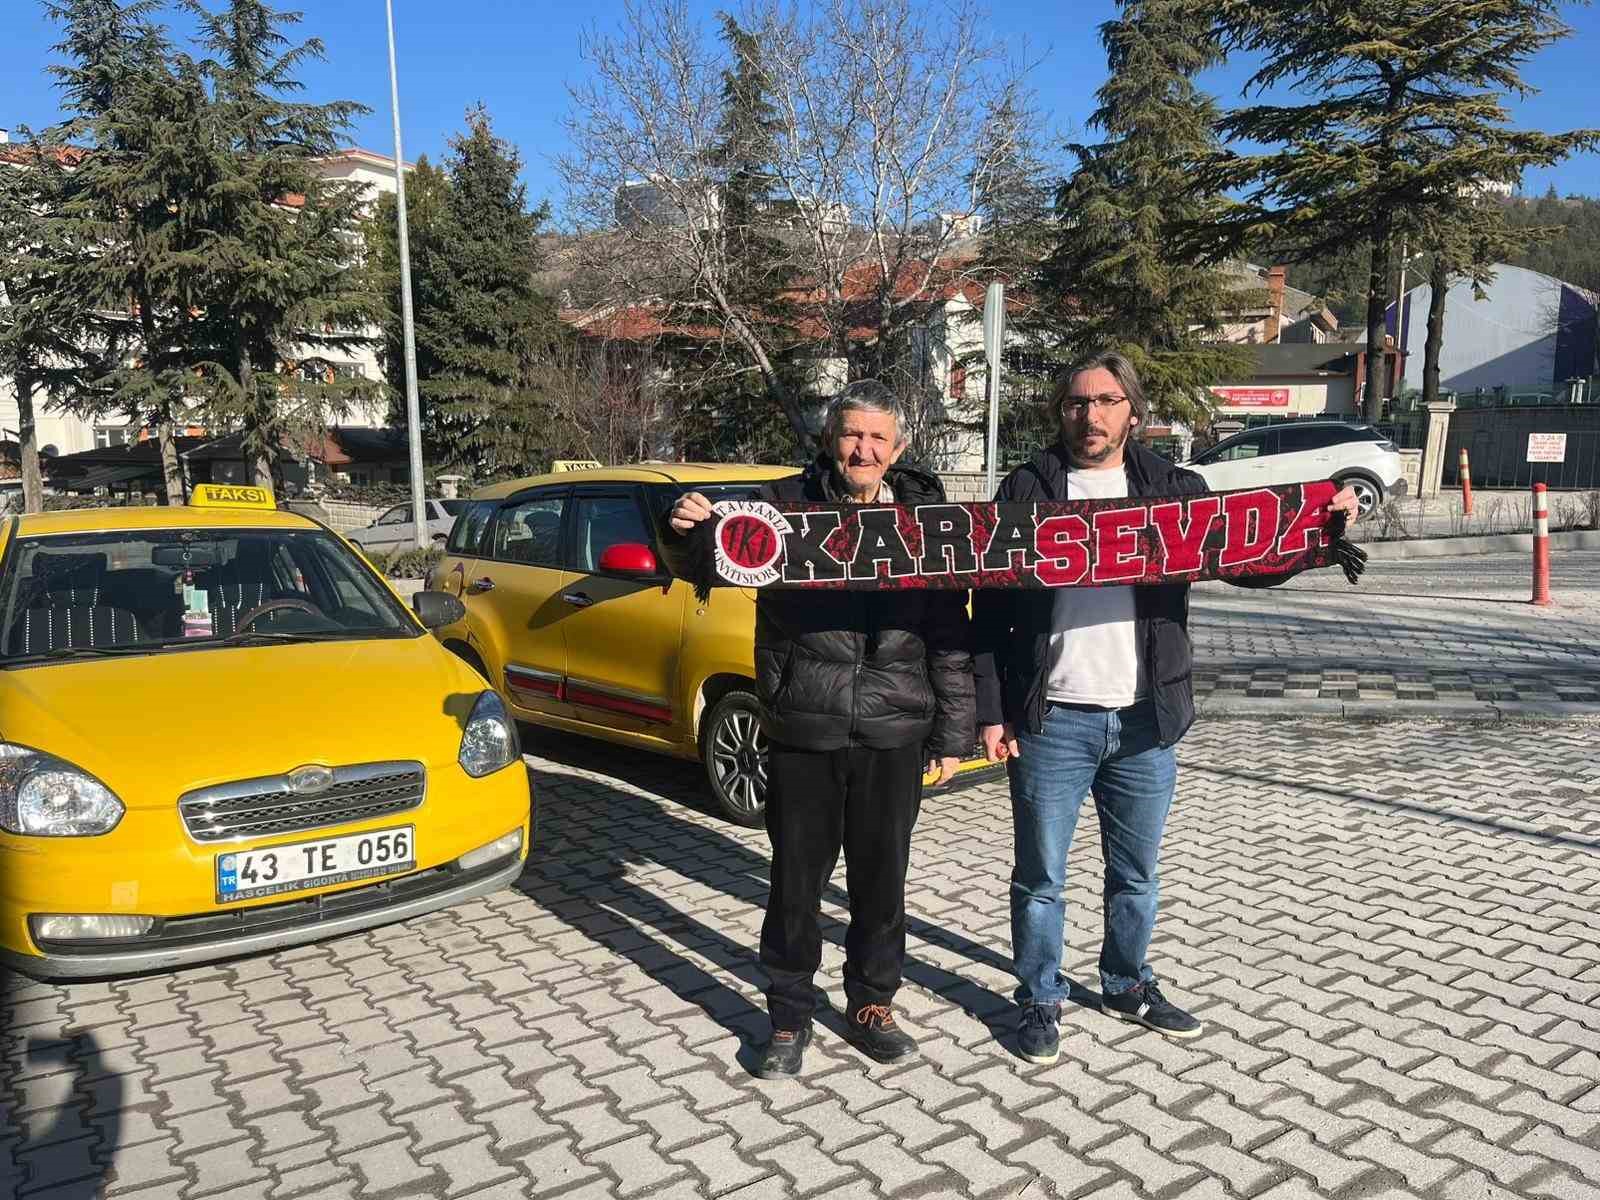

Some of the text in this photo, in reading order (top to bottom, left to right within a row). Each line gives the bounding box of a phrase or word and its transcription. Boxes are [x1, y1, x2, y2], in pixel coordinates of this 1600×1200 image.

[241, 853, 278, 883] 43
[302, 844, 337, 874] TE
[357, 832, 408, 865] 056
[222, 875, 236, 886] TR
